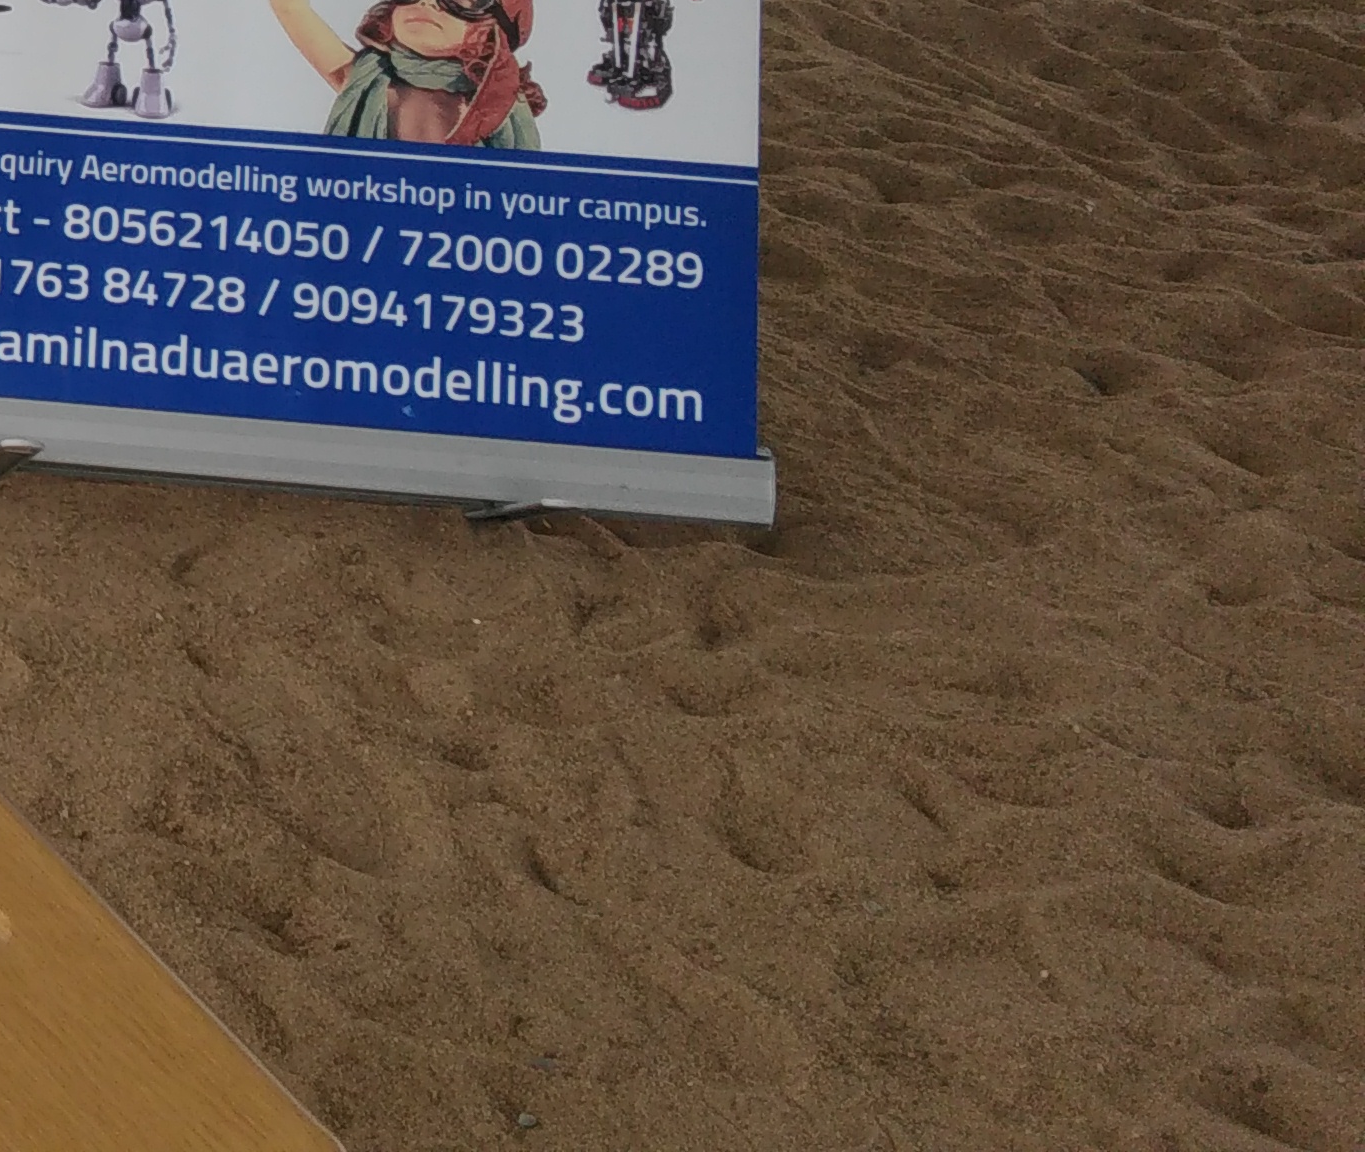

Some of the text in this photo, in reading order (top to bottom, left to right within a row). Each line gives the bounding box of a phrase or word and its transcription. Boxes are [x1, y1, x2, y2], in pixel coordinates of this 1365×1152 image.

[80, 154, 298, 203] Aeromodelling
[306, 175, 457, 214] workshop
[464, 182, 492, 211] in
[501, 193, 570, 219] your
[578, 198, 706, 230] campus.
[33, 218, 50, 226] -
[63, 203, 349, 260] 8056214050
[362, 226, 384, 263] /
[399, 229, 543, 276] 72000
[556, 242, 704, 289] 02289
[103, 267, 246, 313] 84728
[259, 279, 280, 316] /
[293, 282, 584, 342] 9094179323
